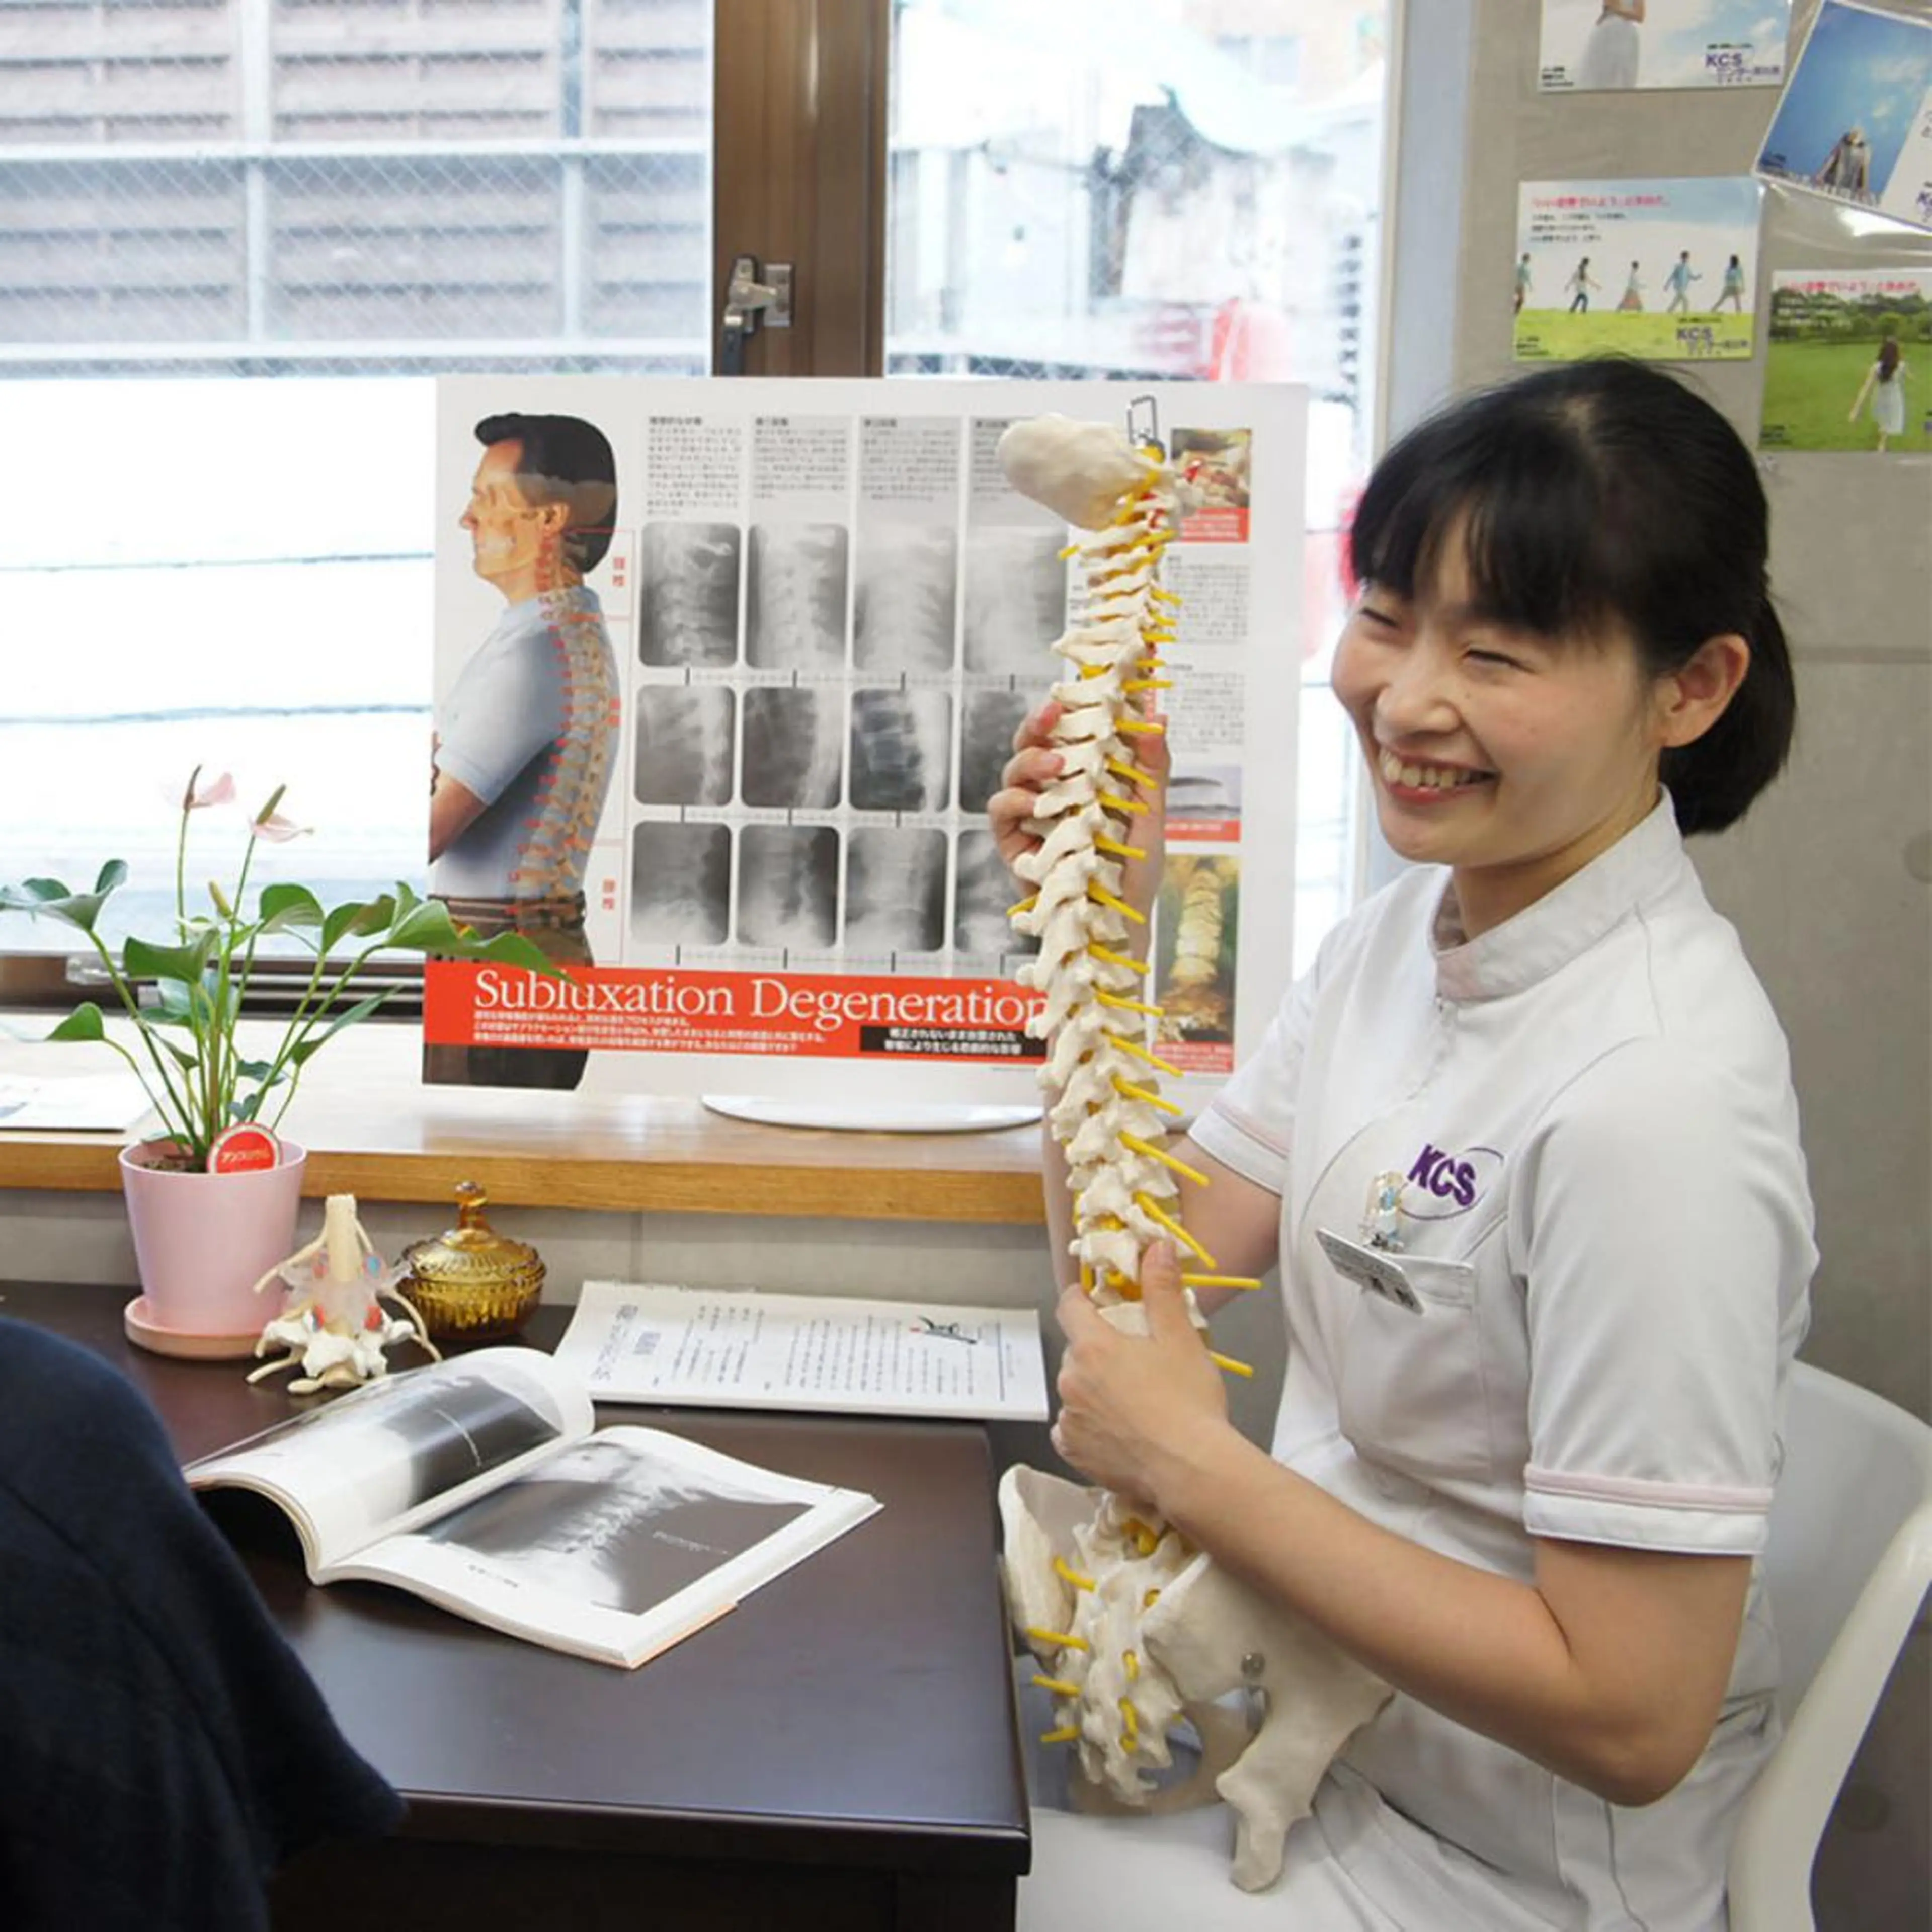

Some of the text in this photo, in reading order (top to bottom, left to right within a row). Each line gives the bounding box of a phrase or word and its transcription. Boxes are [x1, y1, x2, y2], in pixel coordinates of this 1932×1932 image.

[1706, 53, 1742, 67] KCS
[1676, 327, 1713, 341] KCS
[475, 969, 733, 1016] Subluxation
[1406, 1143, 1476, 1206] KCS
